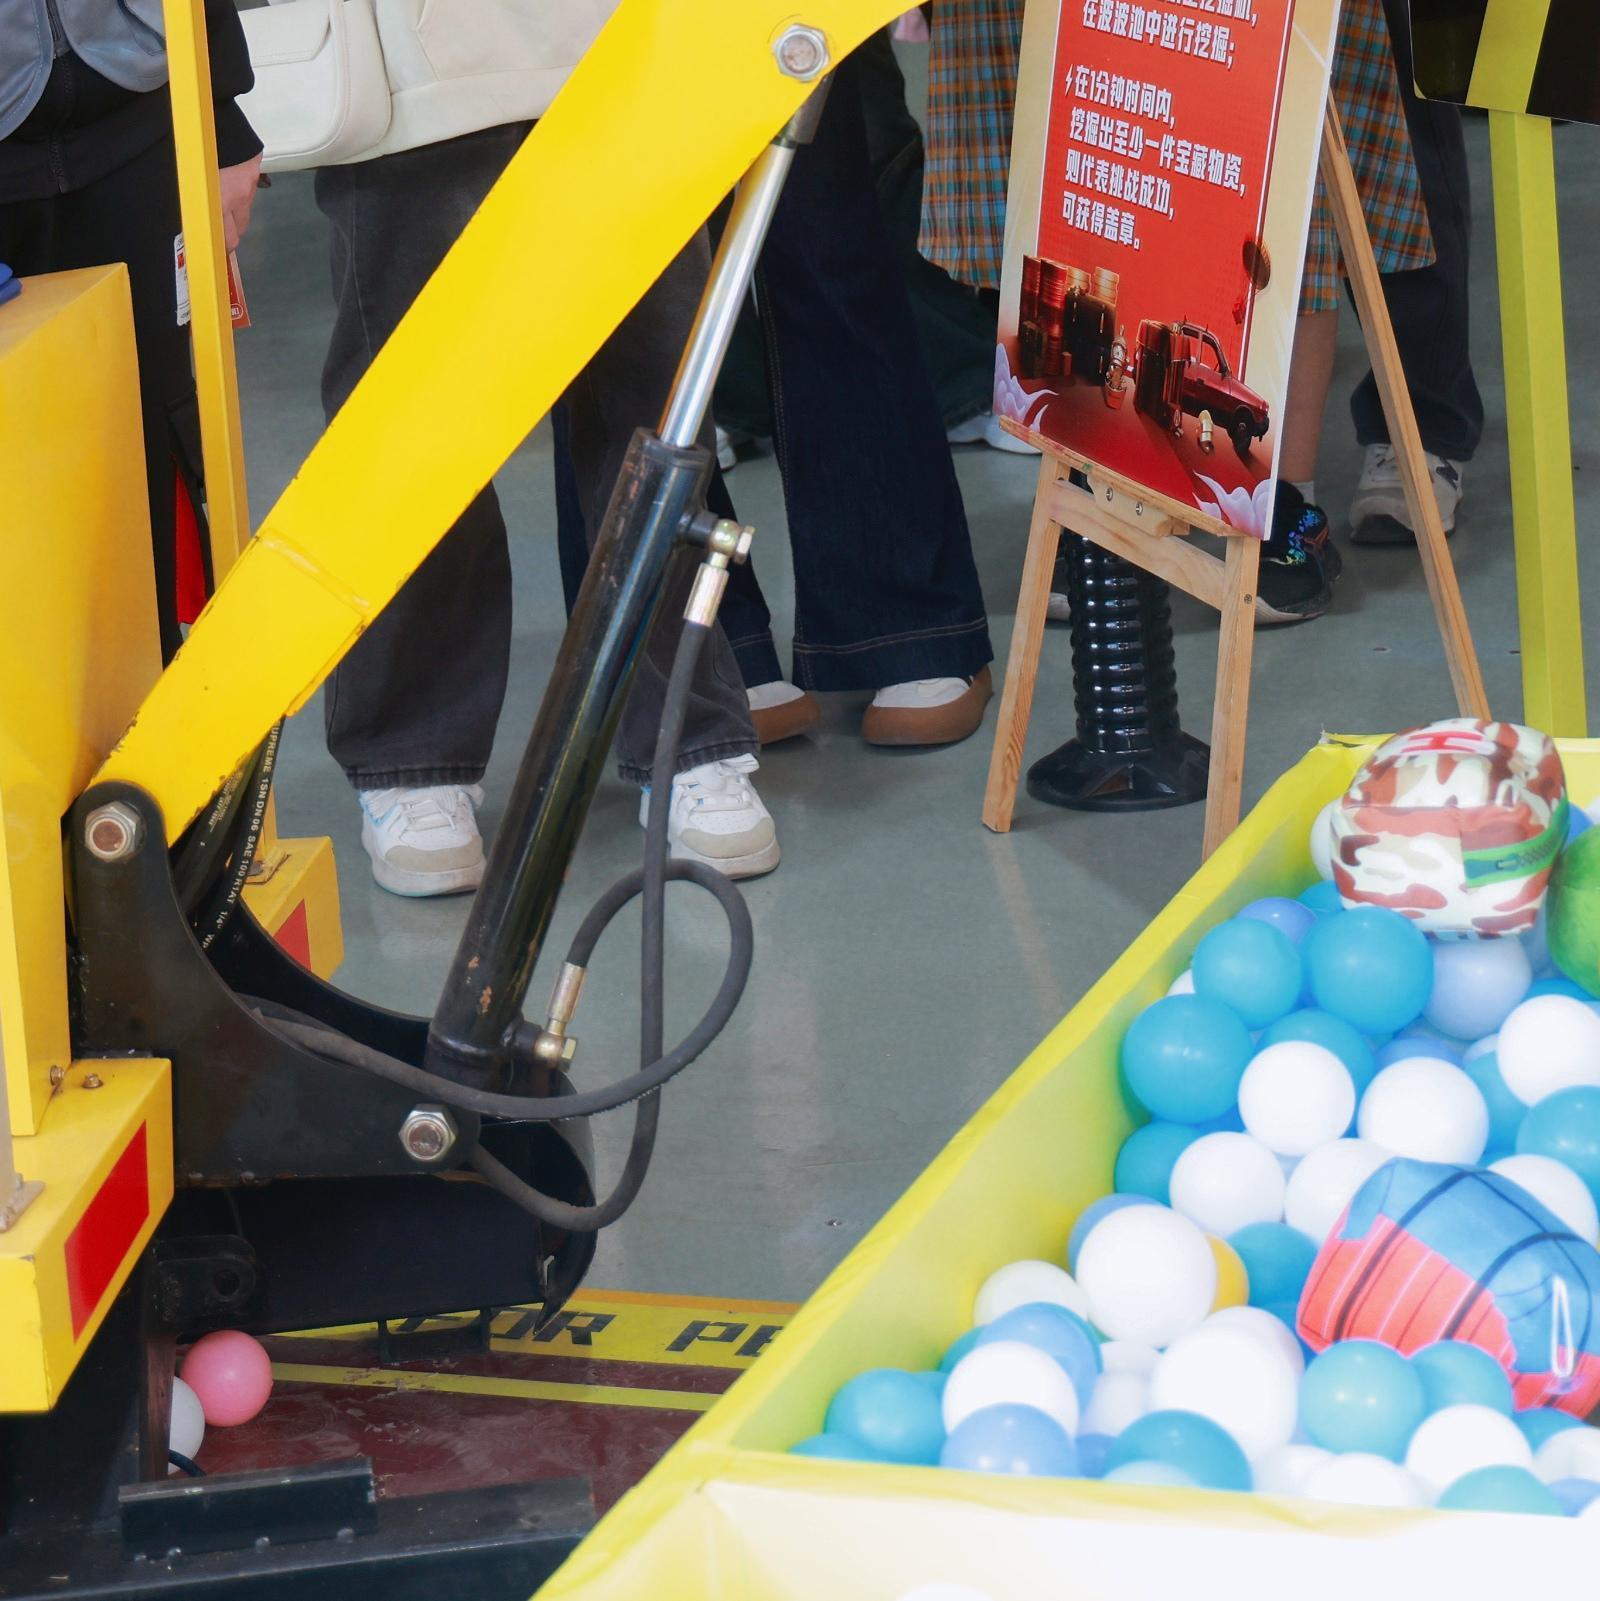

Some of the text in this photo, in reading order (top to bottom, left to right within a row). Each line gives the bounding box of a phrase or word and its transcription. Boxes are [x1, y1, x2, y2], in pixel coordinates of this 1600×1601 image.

[1062, 191, 1141, 250] 可获得盖章。
[243, 835, 256, 857] SAE
